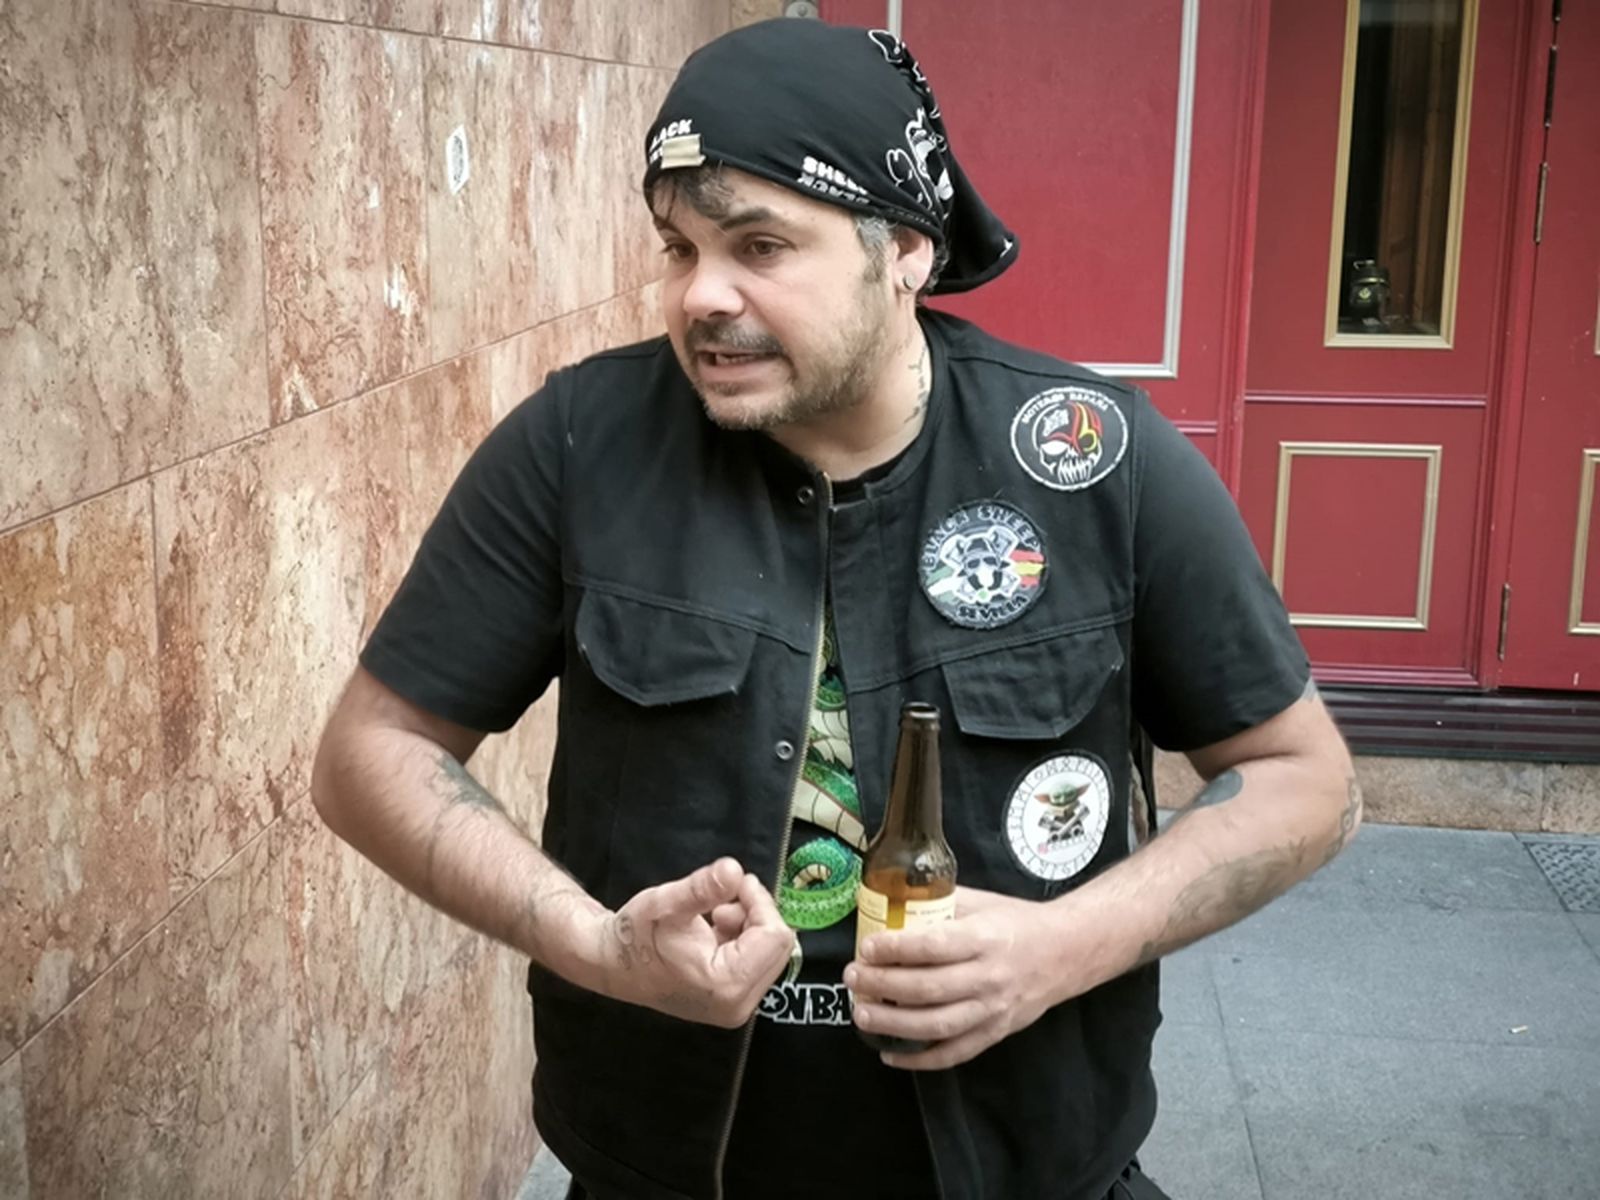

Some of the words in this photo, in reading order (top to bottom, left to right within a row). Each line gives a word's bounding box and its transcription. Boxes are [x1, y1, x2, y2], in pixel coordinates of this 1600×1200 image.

[649, 119, 692, 152] LACK
[923, 509, 969, 572] BLACK
[977, 505, 1041, 552] SHEEP
